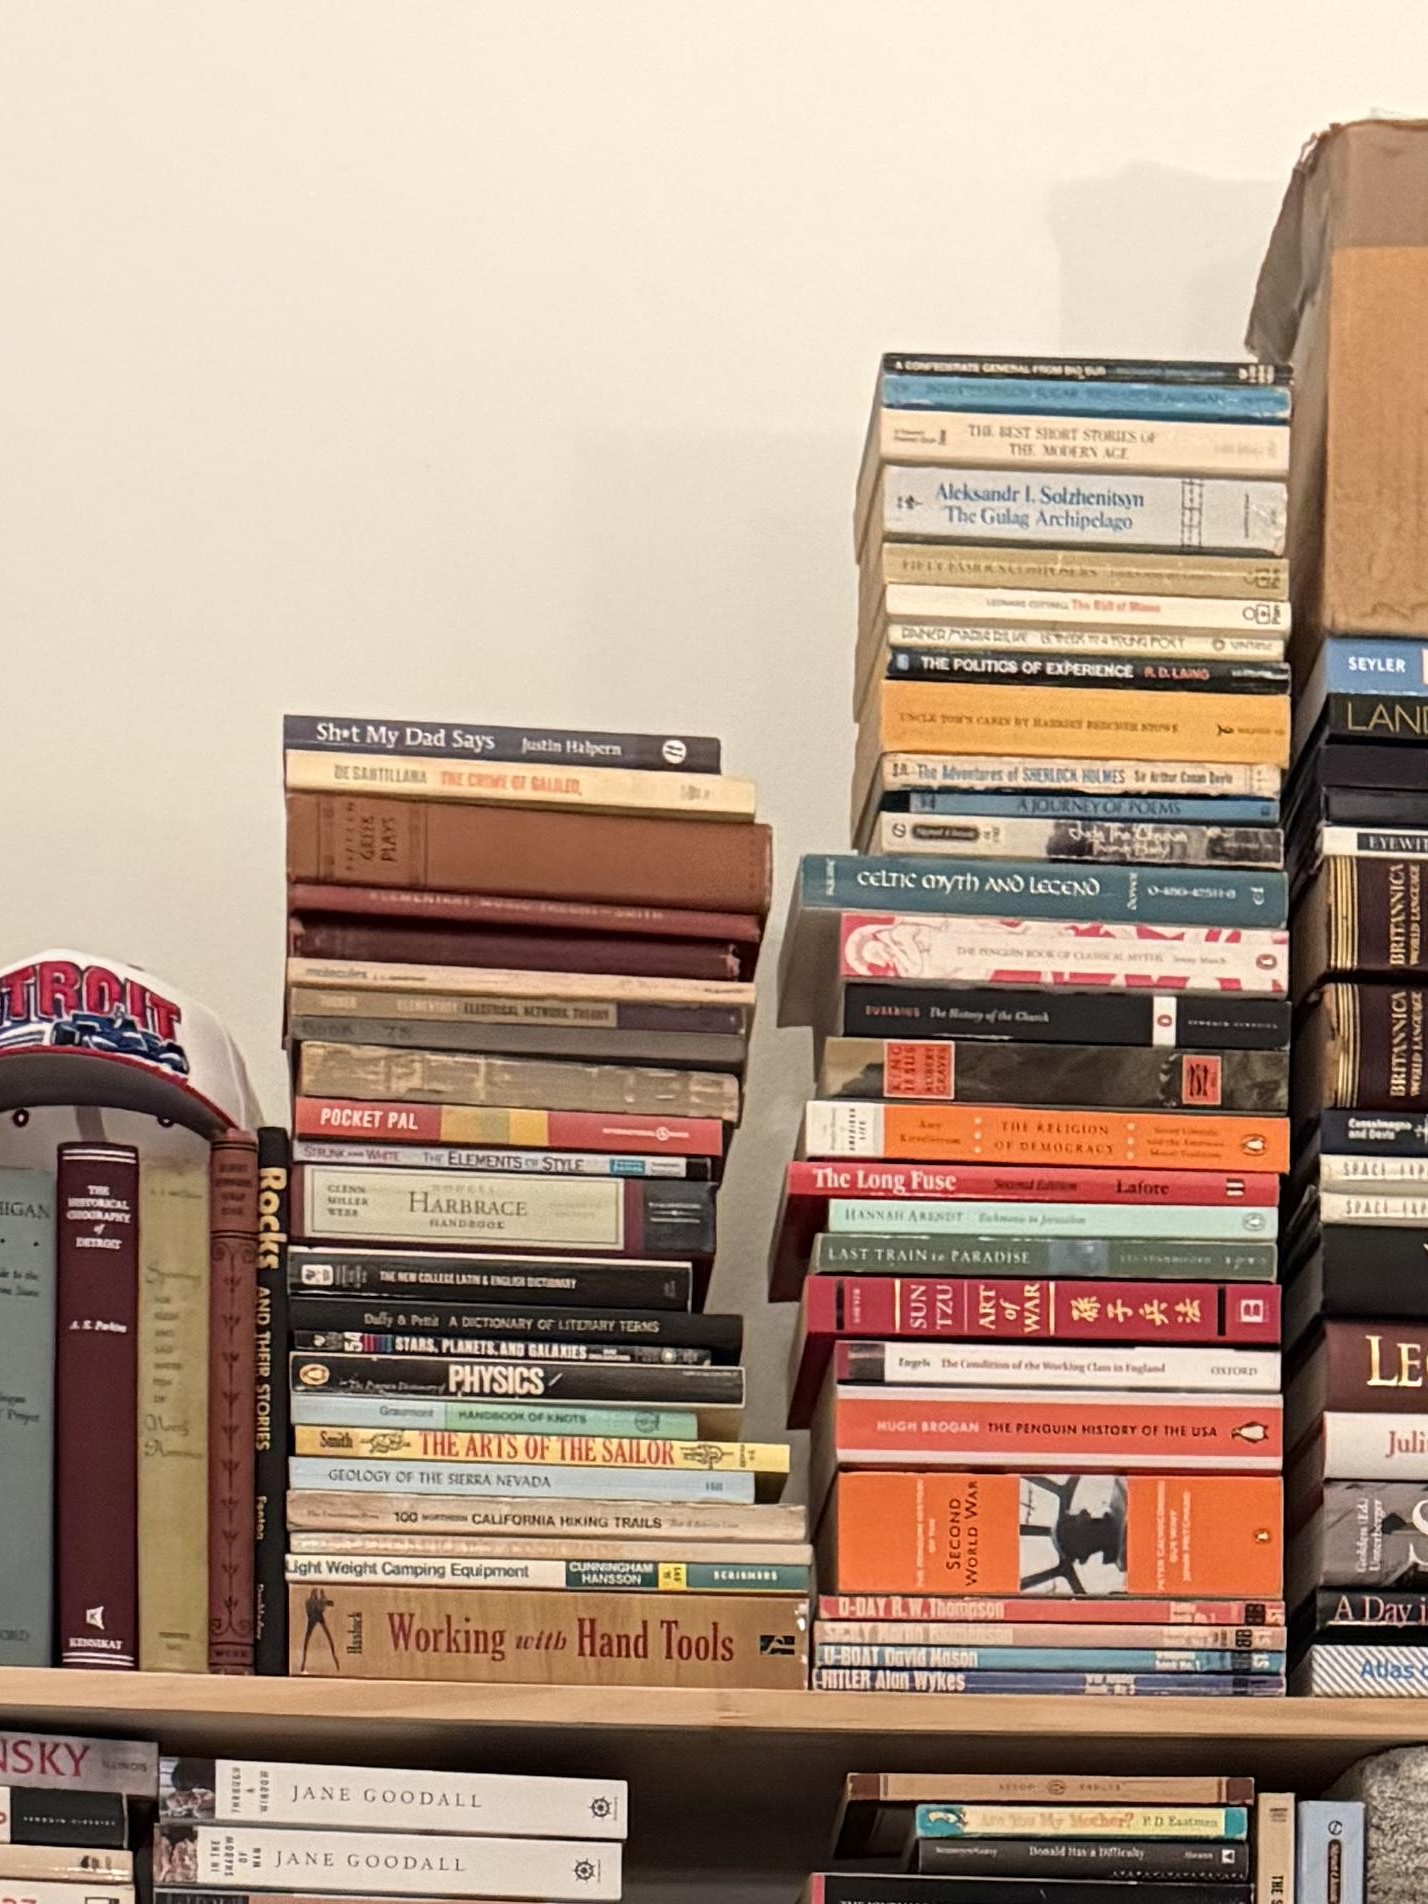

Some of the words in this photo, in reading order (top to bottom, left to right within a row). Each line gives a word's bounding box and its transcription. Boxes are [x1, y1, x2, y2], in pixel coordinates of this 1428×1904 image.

[366, 727, 399, 748] My
[405, 727, 445, 747] Dad
[453, 730, 495, 751] Says
[814, 1168, 850, 1189] The
[856, 1168, 905, 1193] Long
[911, 1171, 956, 1191] Fuse
[387, 1613, 506, 1660] Working
[515, 1629, 566, 1651] with
[577, 1618, 651, 1658] Hand
[660, 1621, 734, 1661] Tools
